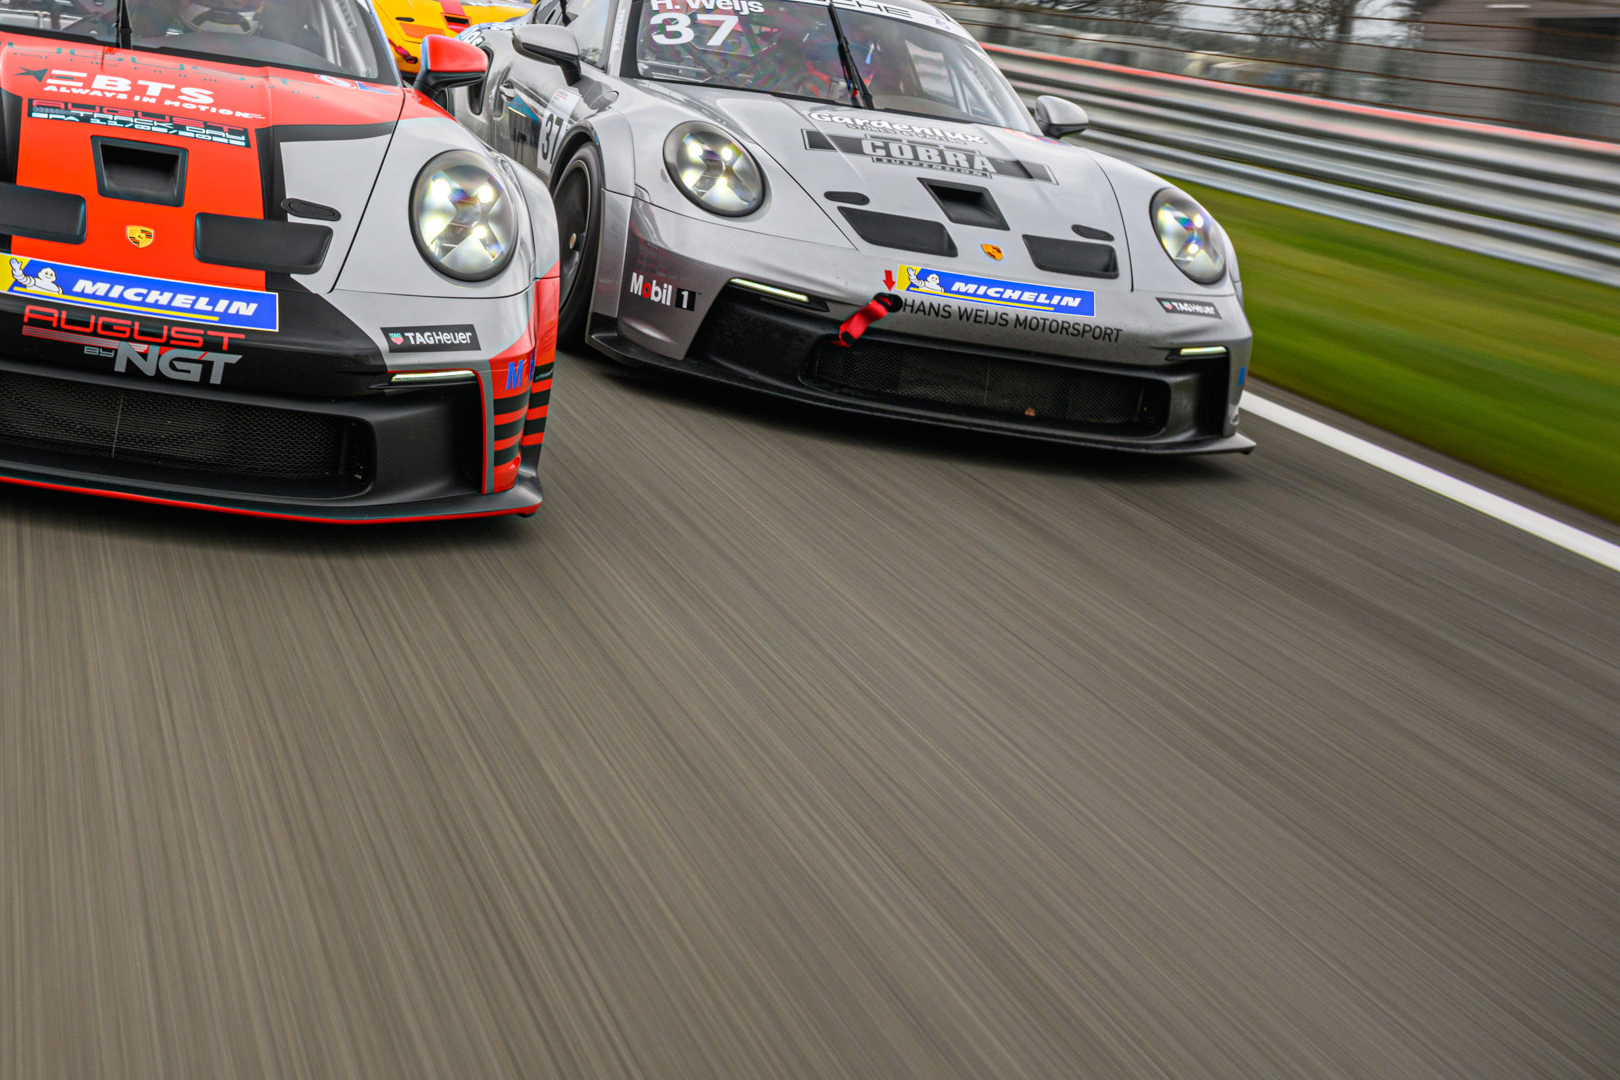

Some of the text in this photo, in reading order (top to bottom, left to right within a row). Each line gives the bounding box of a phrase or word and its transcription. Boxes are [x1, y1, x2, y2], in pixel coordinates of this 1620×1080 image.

[650, 12, 739, 46] 37
[32, 99, 244, 133] AUGUST
[32, 112, 80, 122] SPA
[44, 85, 253, 119] ALWAYS IN MOTION
[69, 110, 175, 129] TRACK
[186, 126, 246, 141] DAY
[541, 113, 564, 164] 37
[810, 112, 984, 144] Gardenlux
[861, 139, 997, 172] COBRA
[881, 158, 983, 177] SUSPENSION
[72, 279, 258, 316] MICHELIN
[630, 272, 673, 307] Mobil
[950, 281, 1082, 307] MICHELIN
[23, 305, 246, 351] AUGUST
[902, 298, 1123, 344] HANS WEIJS MOTORSPORT
[114, 342, 243, 385] NGT
